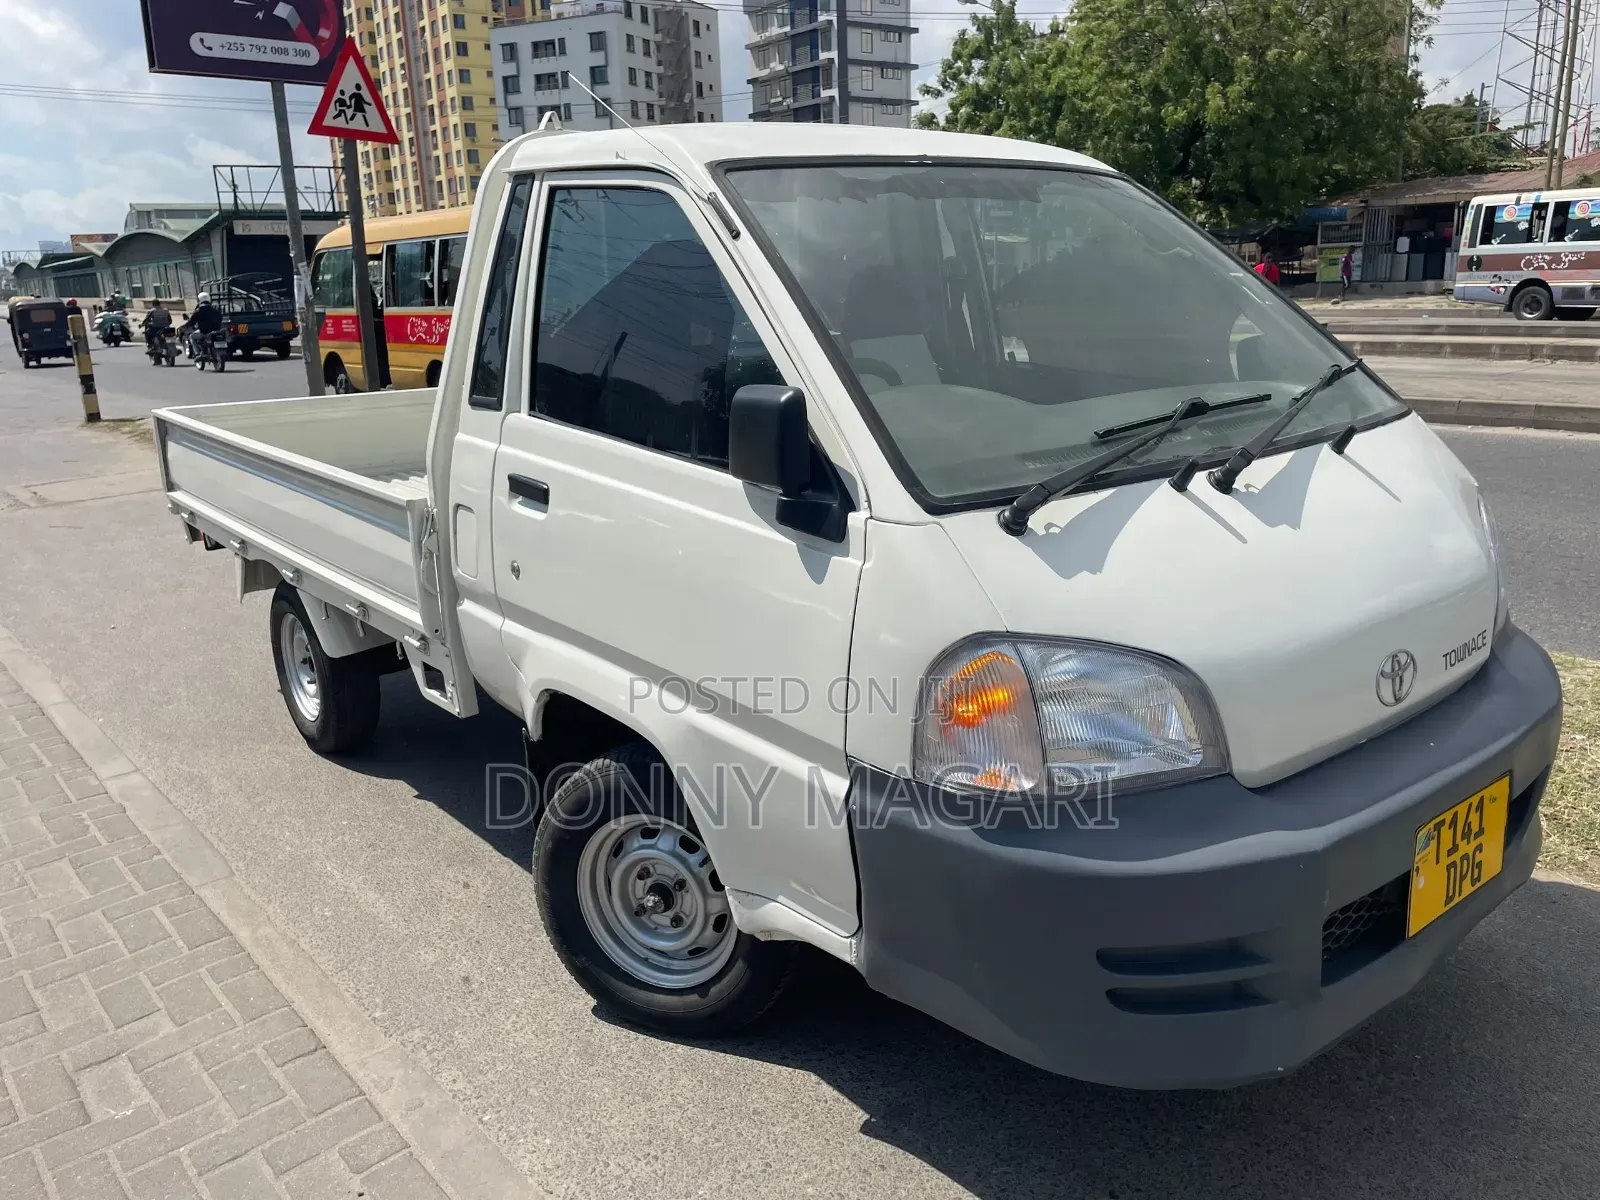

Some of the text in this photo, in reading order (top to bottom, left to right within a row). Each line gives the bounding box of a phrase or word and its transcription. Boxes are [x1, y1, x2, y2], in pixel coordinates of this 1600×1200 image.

[219, 41, 311, 59] +255 792 008 300
[1442, 629, 1487, 671] TOWNACE
[1433, 794, 1485, 866] T141
[1444, 842, 1484, 908] DPG
